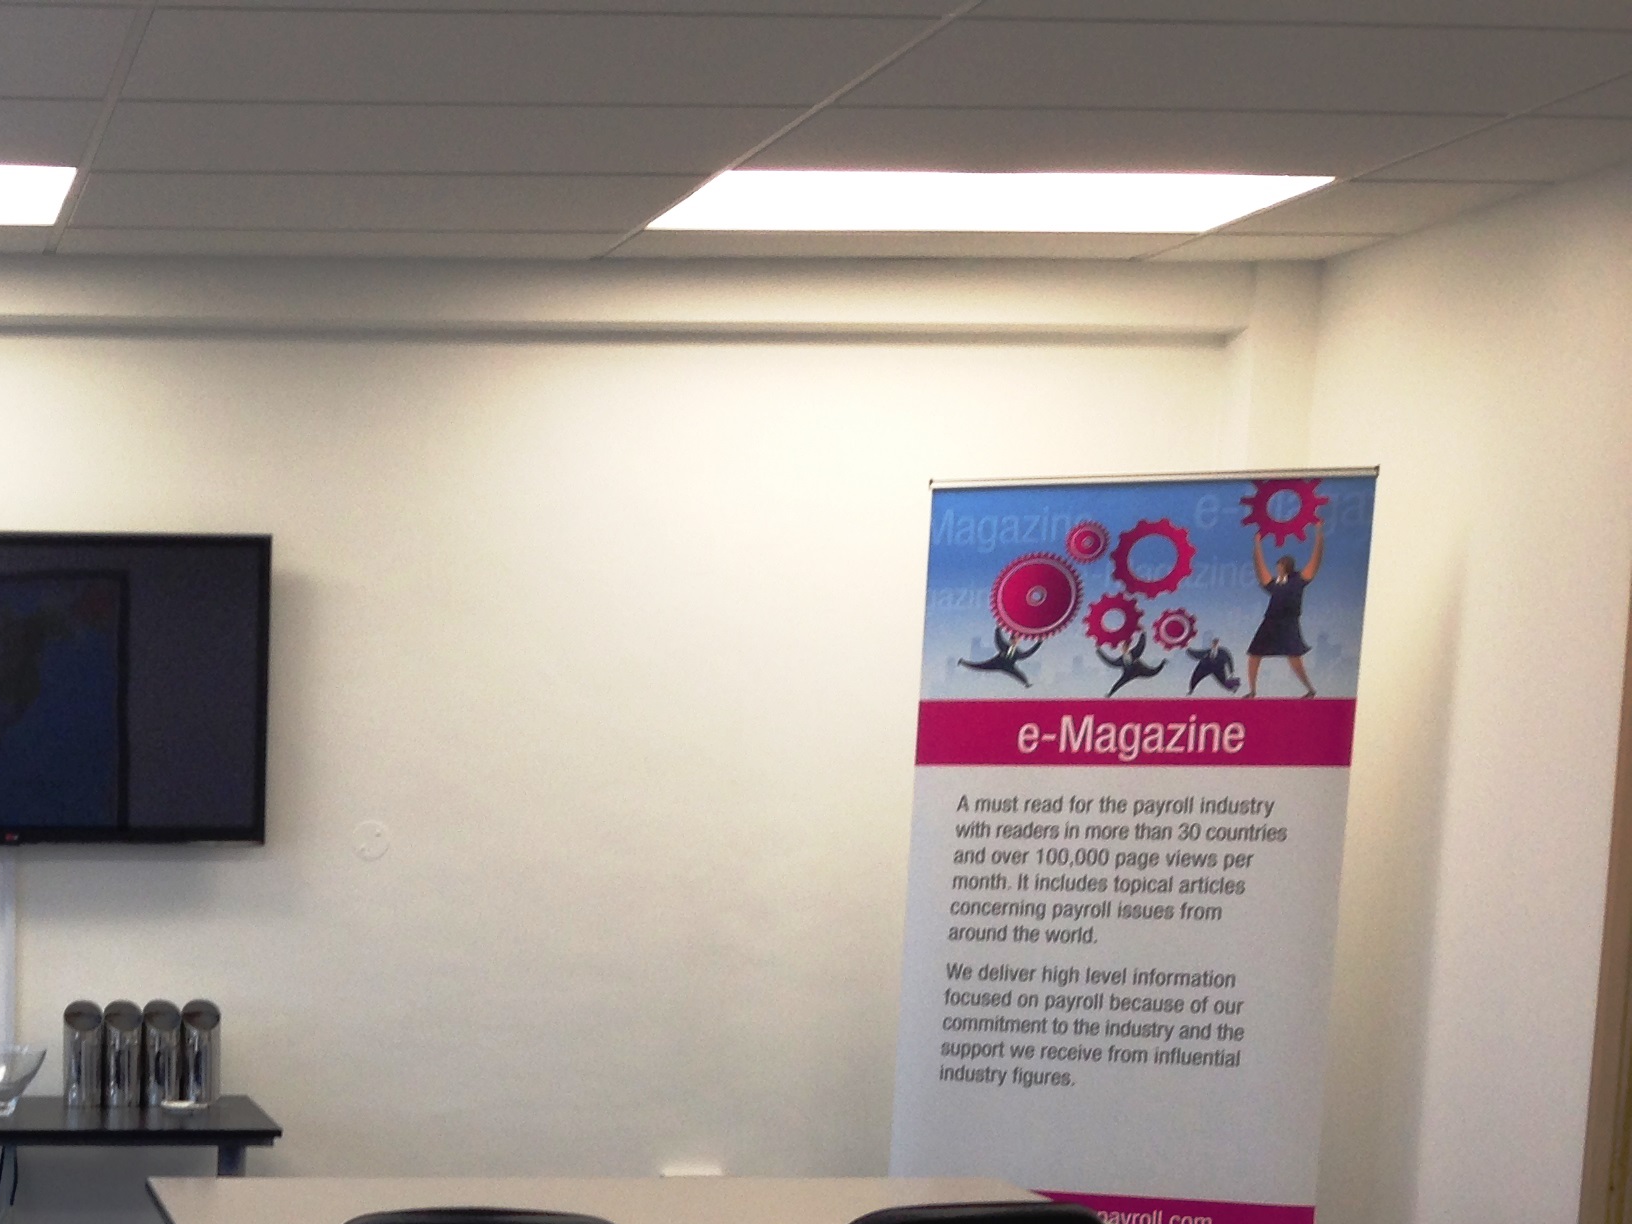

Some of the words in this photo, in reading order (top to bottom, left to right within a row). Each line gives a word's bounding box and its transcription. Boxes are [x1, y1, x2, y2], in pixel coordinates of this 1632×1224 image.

[1016, 713, 1246, 761] e-Magazine
[955, 794, 969, 812] A
[974, 795, 1019, 813] must
[1023, 794, 1064, 814] read
[1068, 794, 1094, 814] for
[1098, 795, 1128, 814] the
[1132, 796, 1194, 818] payroll
[1199, 795, 1275, 819] industry
[955, 820, 991, 839] with
[995, 820, 1060, 840] readers
[1063, 821, 1080, 839] in
[1084, 824, 1129, 840] more
[1134, 822, 1173, 841] than
[1177, 821, 1202, 841] 30
[1205, 823, 1287, 842] countries
[953, 846, 986, 865] and
[990, 849, 1030, 865] over
[1036, 847, 1110, 871] 100,000
[1114, 851, 1160, 871] page
[1165, 849, 1218, 868] views
[1222, 853, 1254, 871] per
[1017, 872, 1029, 891] It
[1034, 872, 1108, 893] includes
[1113, 874, 1174, 896] topical
[1178, 875, 1245, 895] articles
[949, 899, 1046, 921] concerning
[1051, 900, 1111, 921] payroll
[1117, 900, 1174, 920] issues
[1179, 901, 1223, 921] from
[947, 924, 1008, 942] around
[1012, 924, 1040, 943] the
[946, 962, 973, 980] We
[977, 963, 1037, 982] deliver
[1041, 965, 1080, 987] high
[1085, 966, 1127, 985] level
[1132, 967, 1236, 988] information
[943, 987, 1012, 1007] focused
[1016, 993, 1039, 1008] on
[1043, 992, 1104, 1013] payroll
[1108, 992, 1185, 1013] because
[1189, 995, 1209, 1014] of
[1212, 999, 1244, 1015] our
[942, 1014, 1048, 1034] commitment
[1051, 1016, 1069, 1035] to
[1072, 1017, 1100, 1036] the
[1104, 1018, 1175, 1042] industry
[1178, 1022, 1212, 1040] and
[1215, 1022, 1245, 1042] the
[940, 1040, 1005, 1061] support
[1009, 1044, 1035, 1060] we
[1039, 1043, 1103, 1063] receive
[1107, 1044, 1150, 1064] from
[1152, 1045, 1241, 1068] influential
[939, 1063, 1008, 1087] industry
